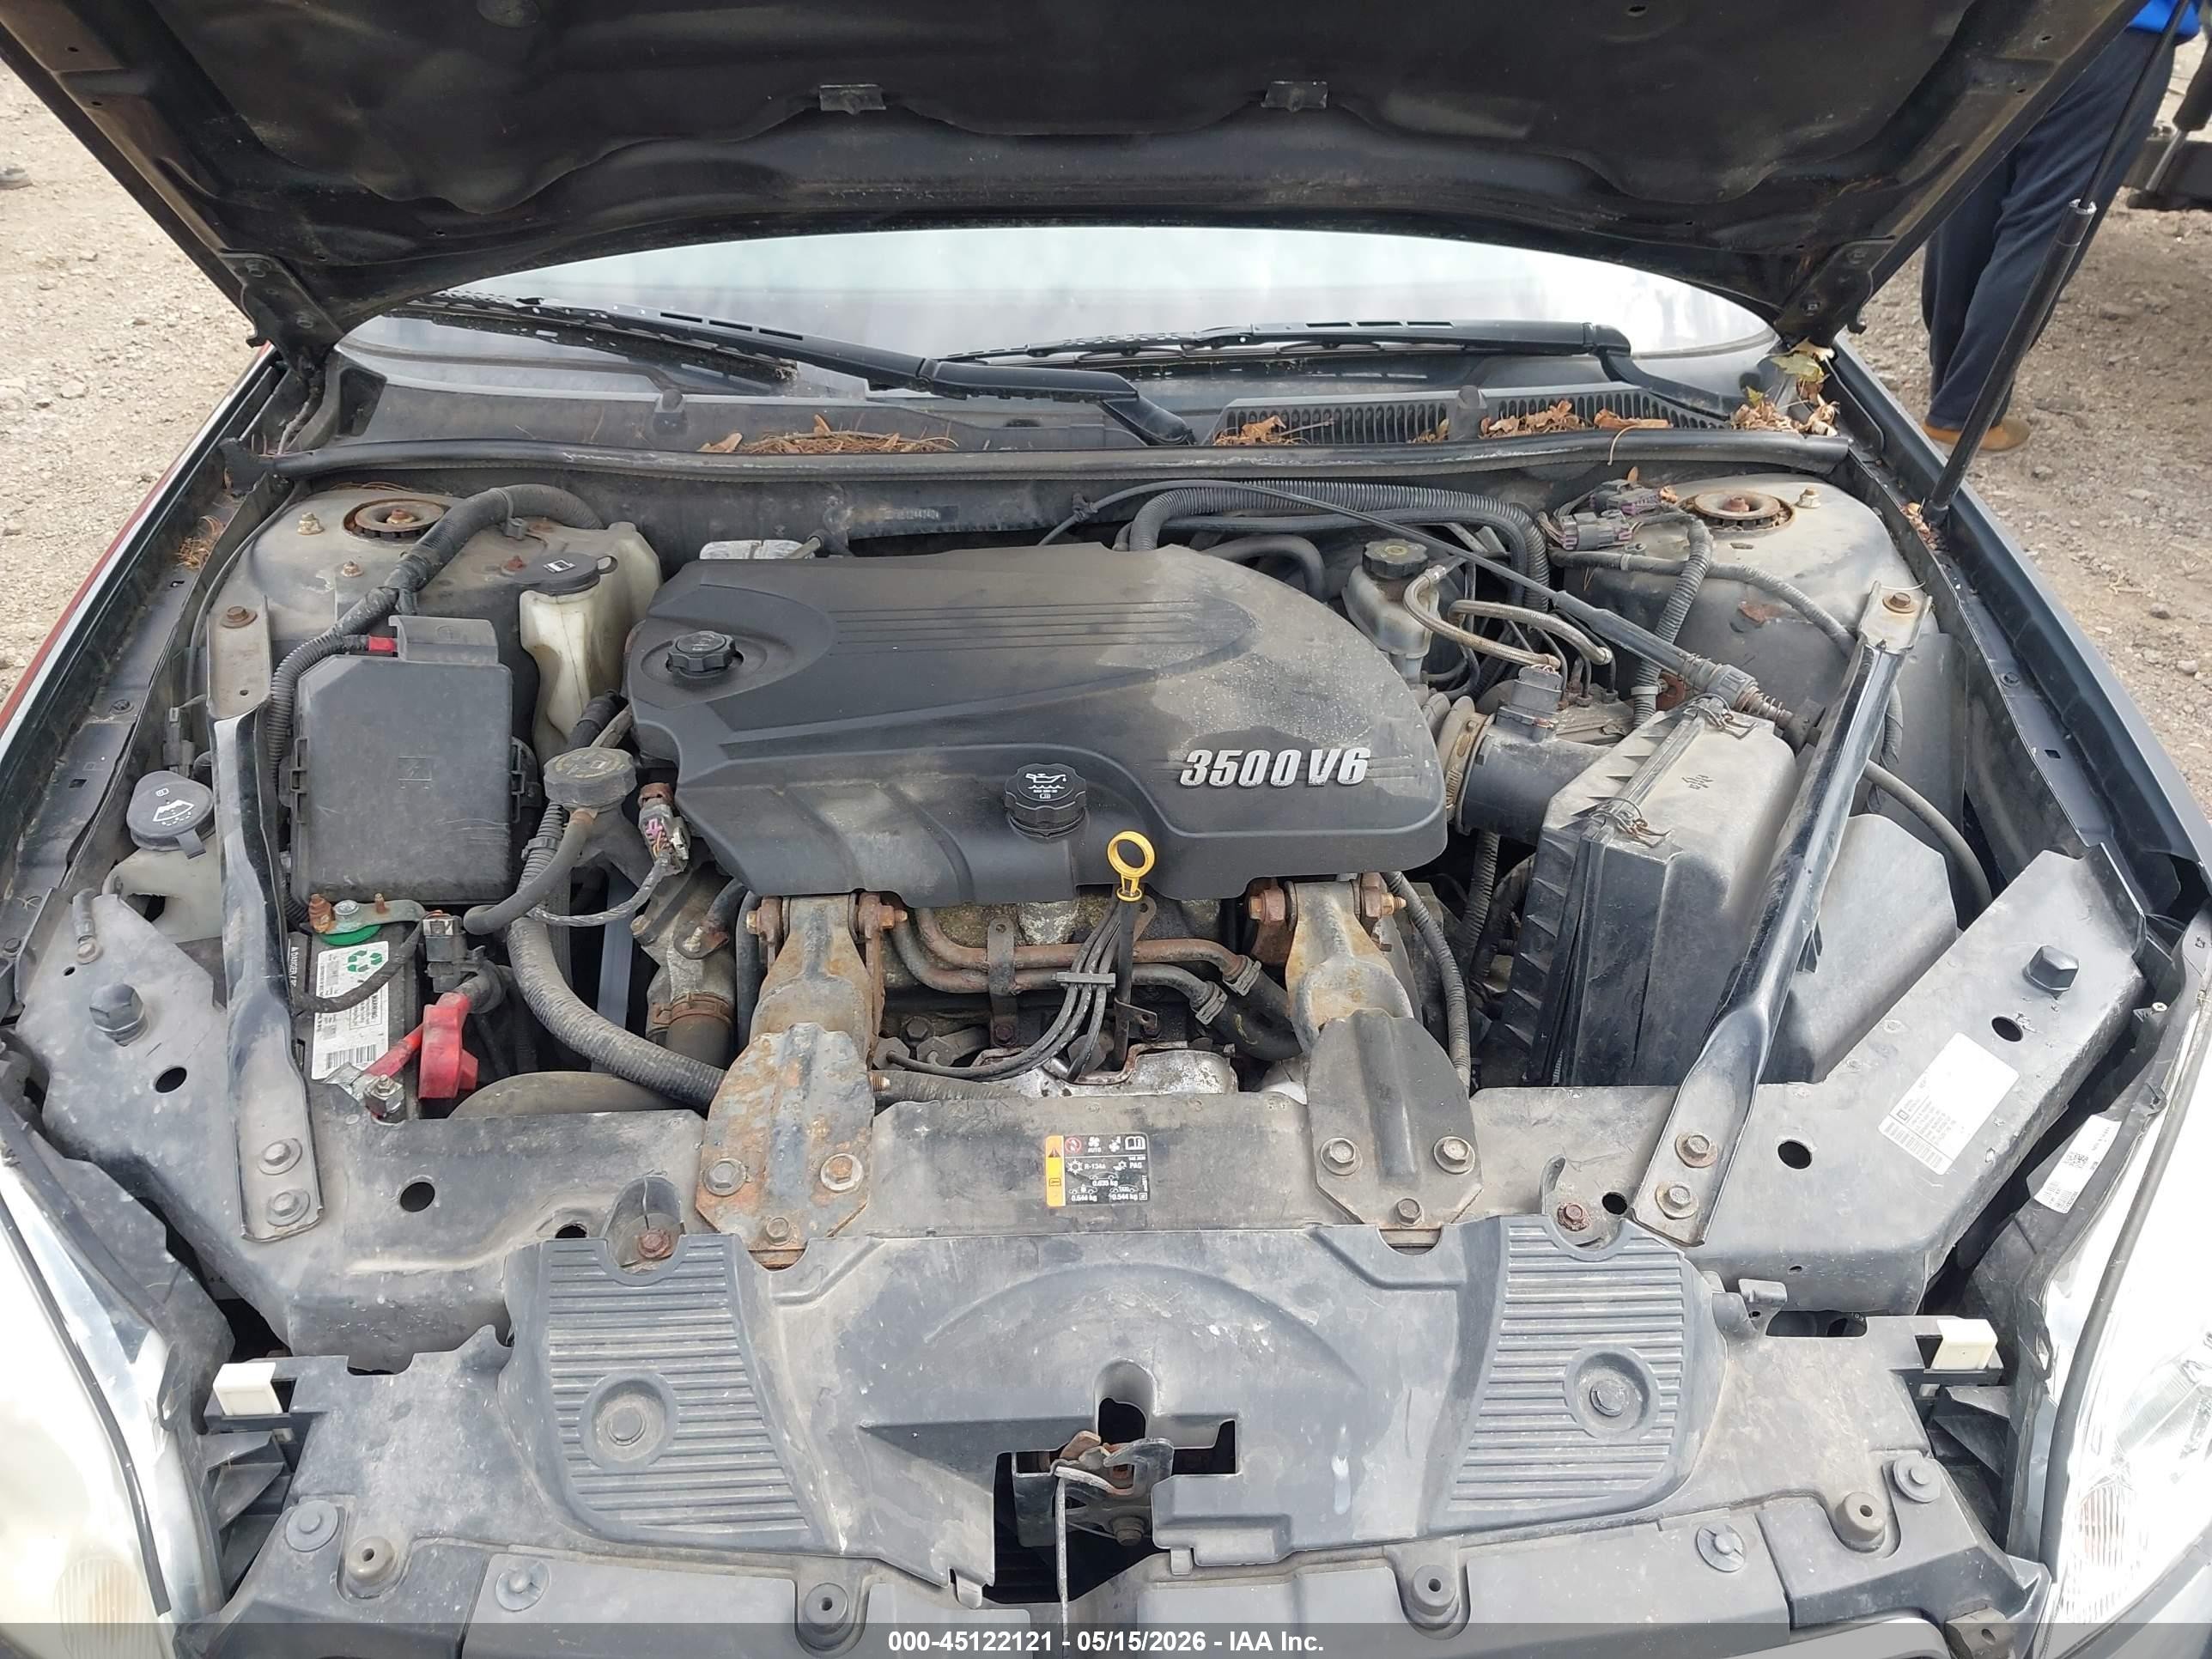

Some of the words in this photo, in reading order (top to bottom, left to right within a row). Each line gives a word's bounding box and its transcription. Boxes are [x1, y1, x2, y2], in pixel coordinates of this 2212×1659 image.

[1179, 749, 1302, 787] 3500
[1307, 747, 1371, 787] V6
[289, 951, 298, 975] DANGER
